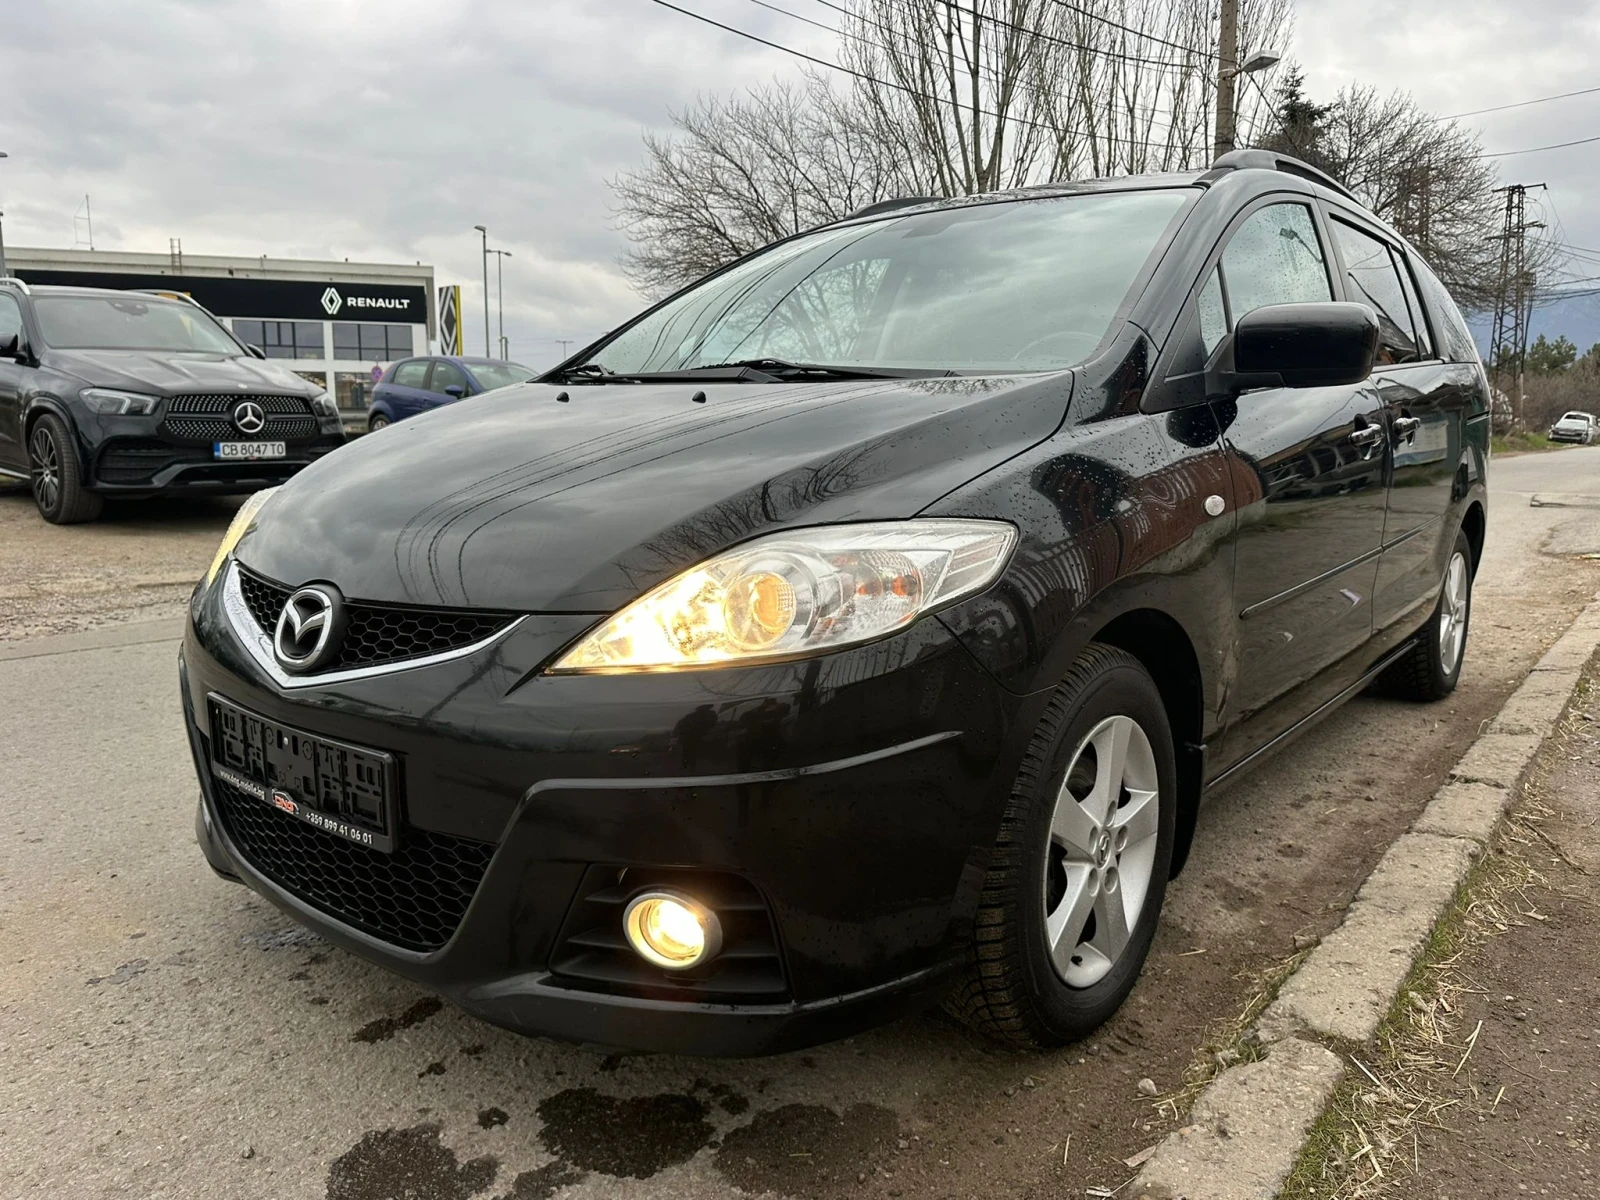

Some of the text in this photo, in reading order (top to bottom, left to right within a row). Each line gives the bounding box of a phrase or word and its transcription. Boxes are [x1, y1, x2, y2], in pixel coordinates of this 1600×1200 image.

[347, 297, 410, 309] RENAULT
[222, 444, 239, 456] CB
[240, 444, 268, 456] 8047
[305, 812, 373, 845] +359 899 41 06 01
